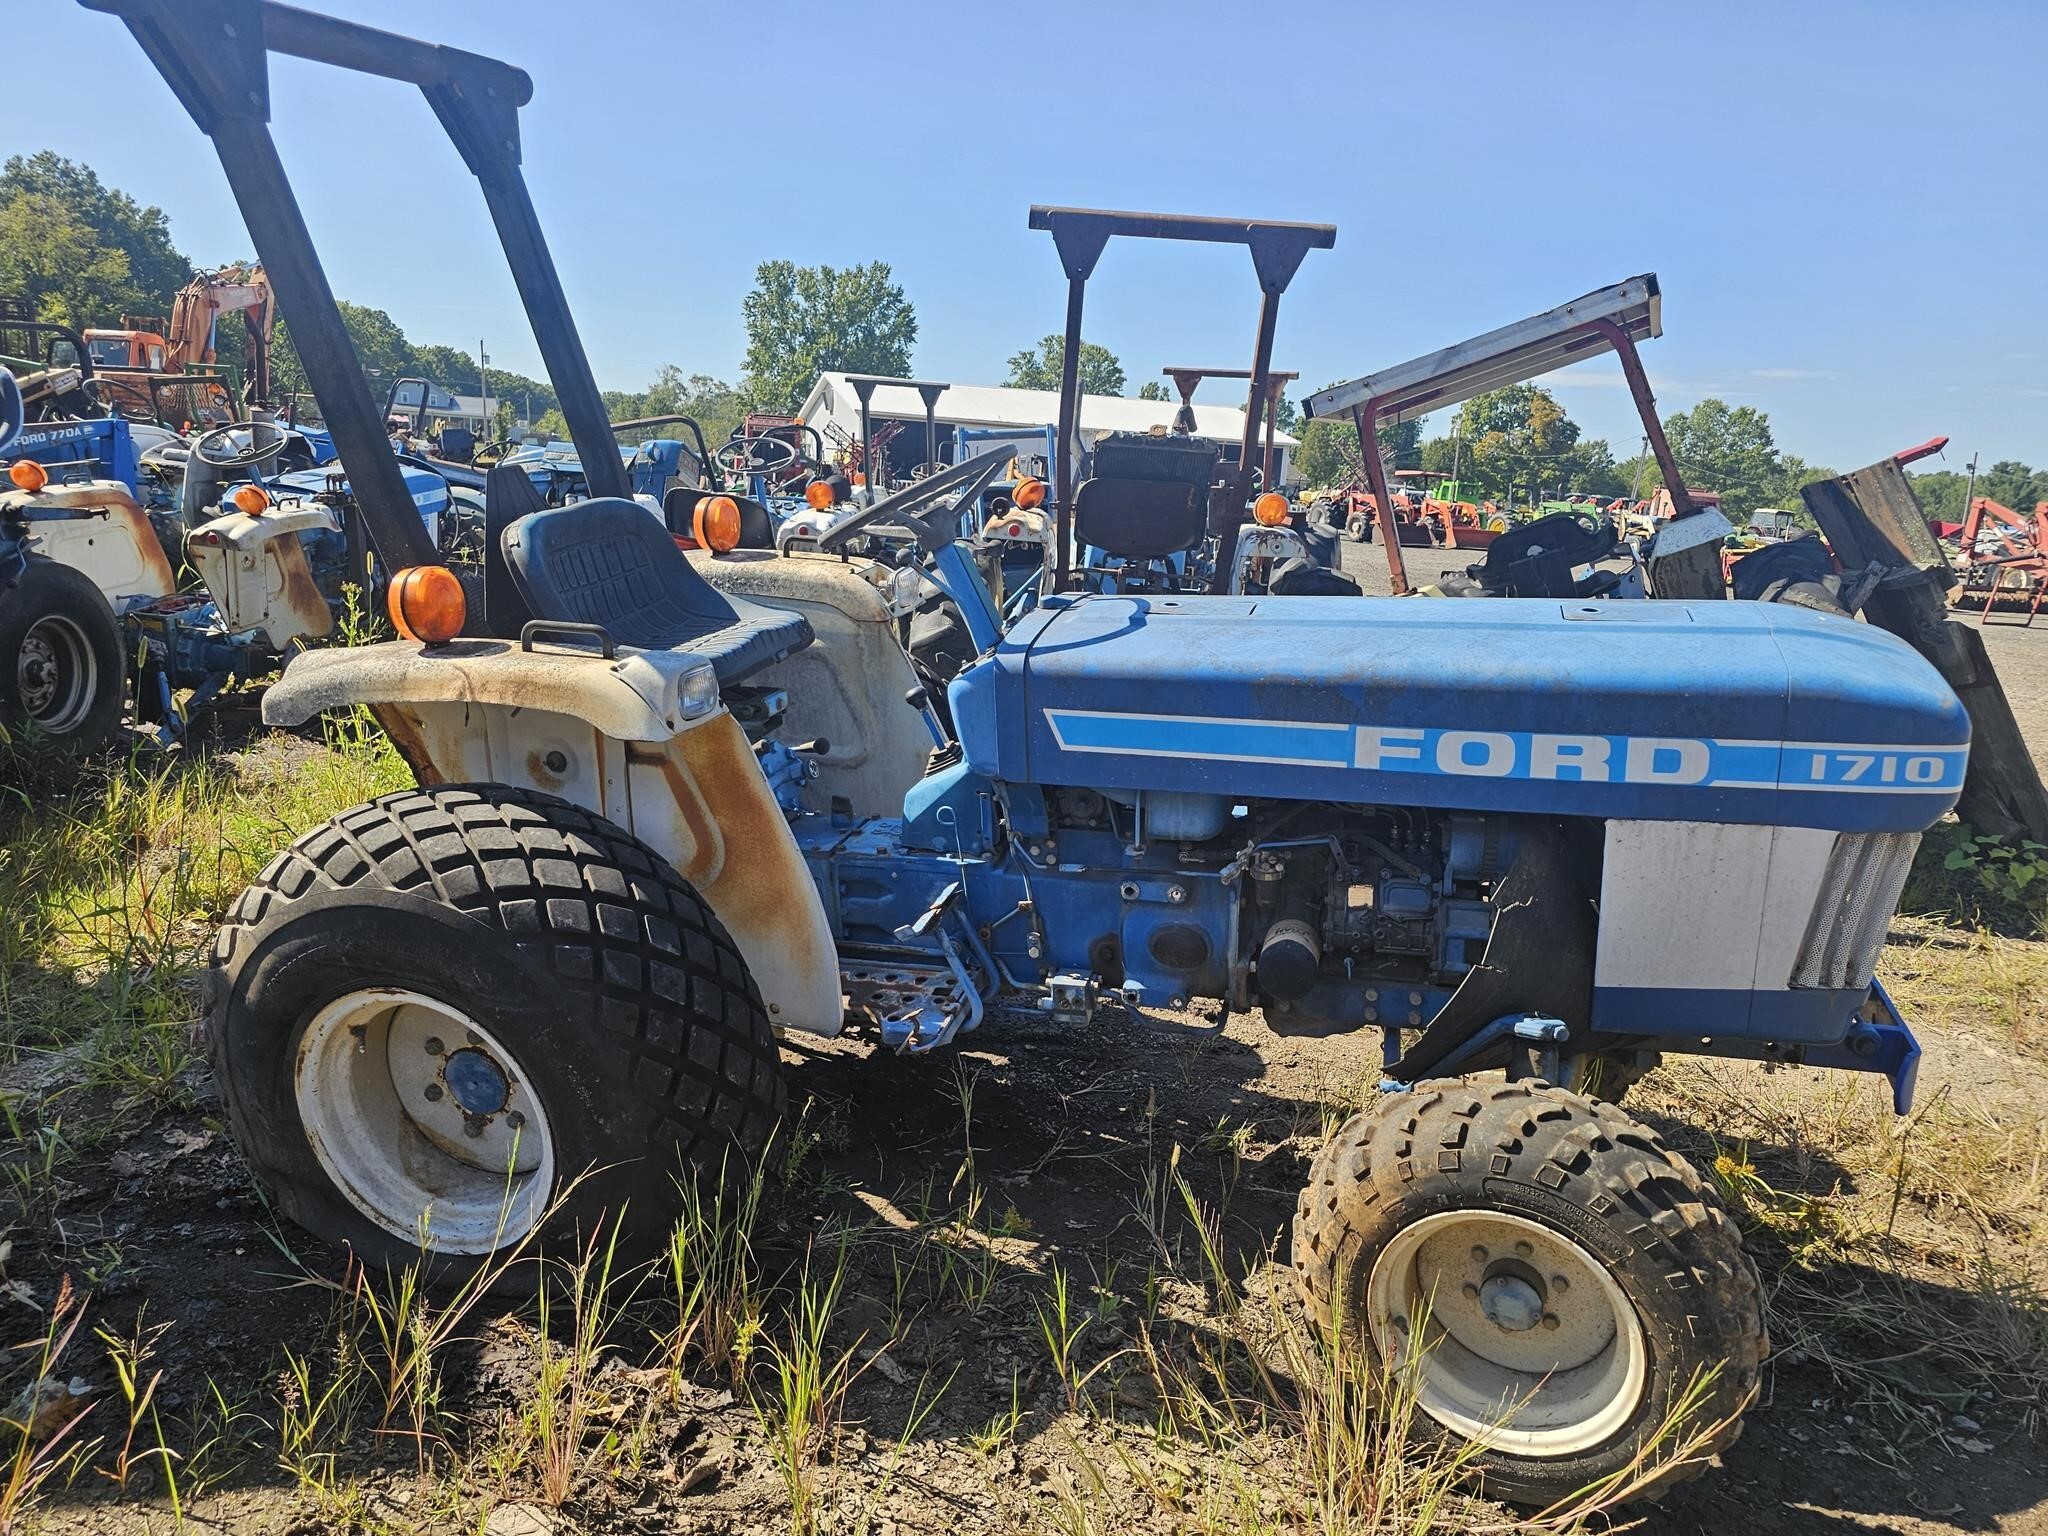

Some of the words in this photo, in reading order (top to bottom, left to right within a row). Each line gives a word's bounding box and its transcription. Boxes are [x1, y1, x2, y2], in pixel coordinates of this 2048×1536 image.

[14, 433, 46, 446] FORD
[50, 427, 82, 440] 770A
[1354, 726, 1710, 784] FORD
[1810, 754, 1945, 783] 1710
